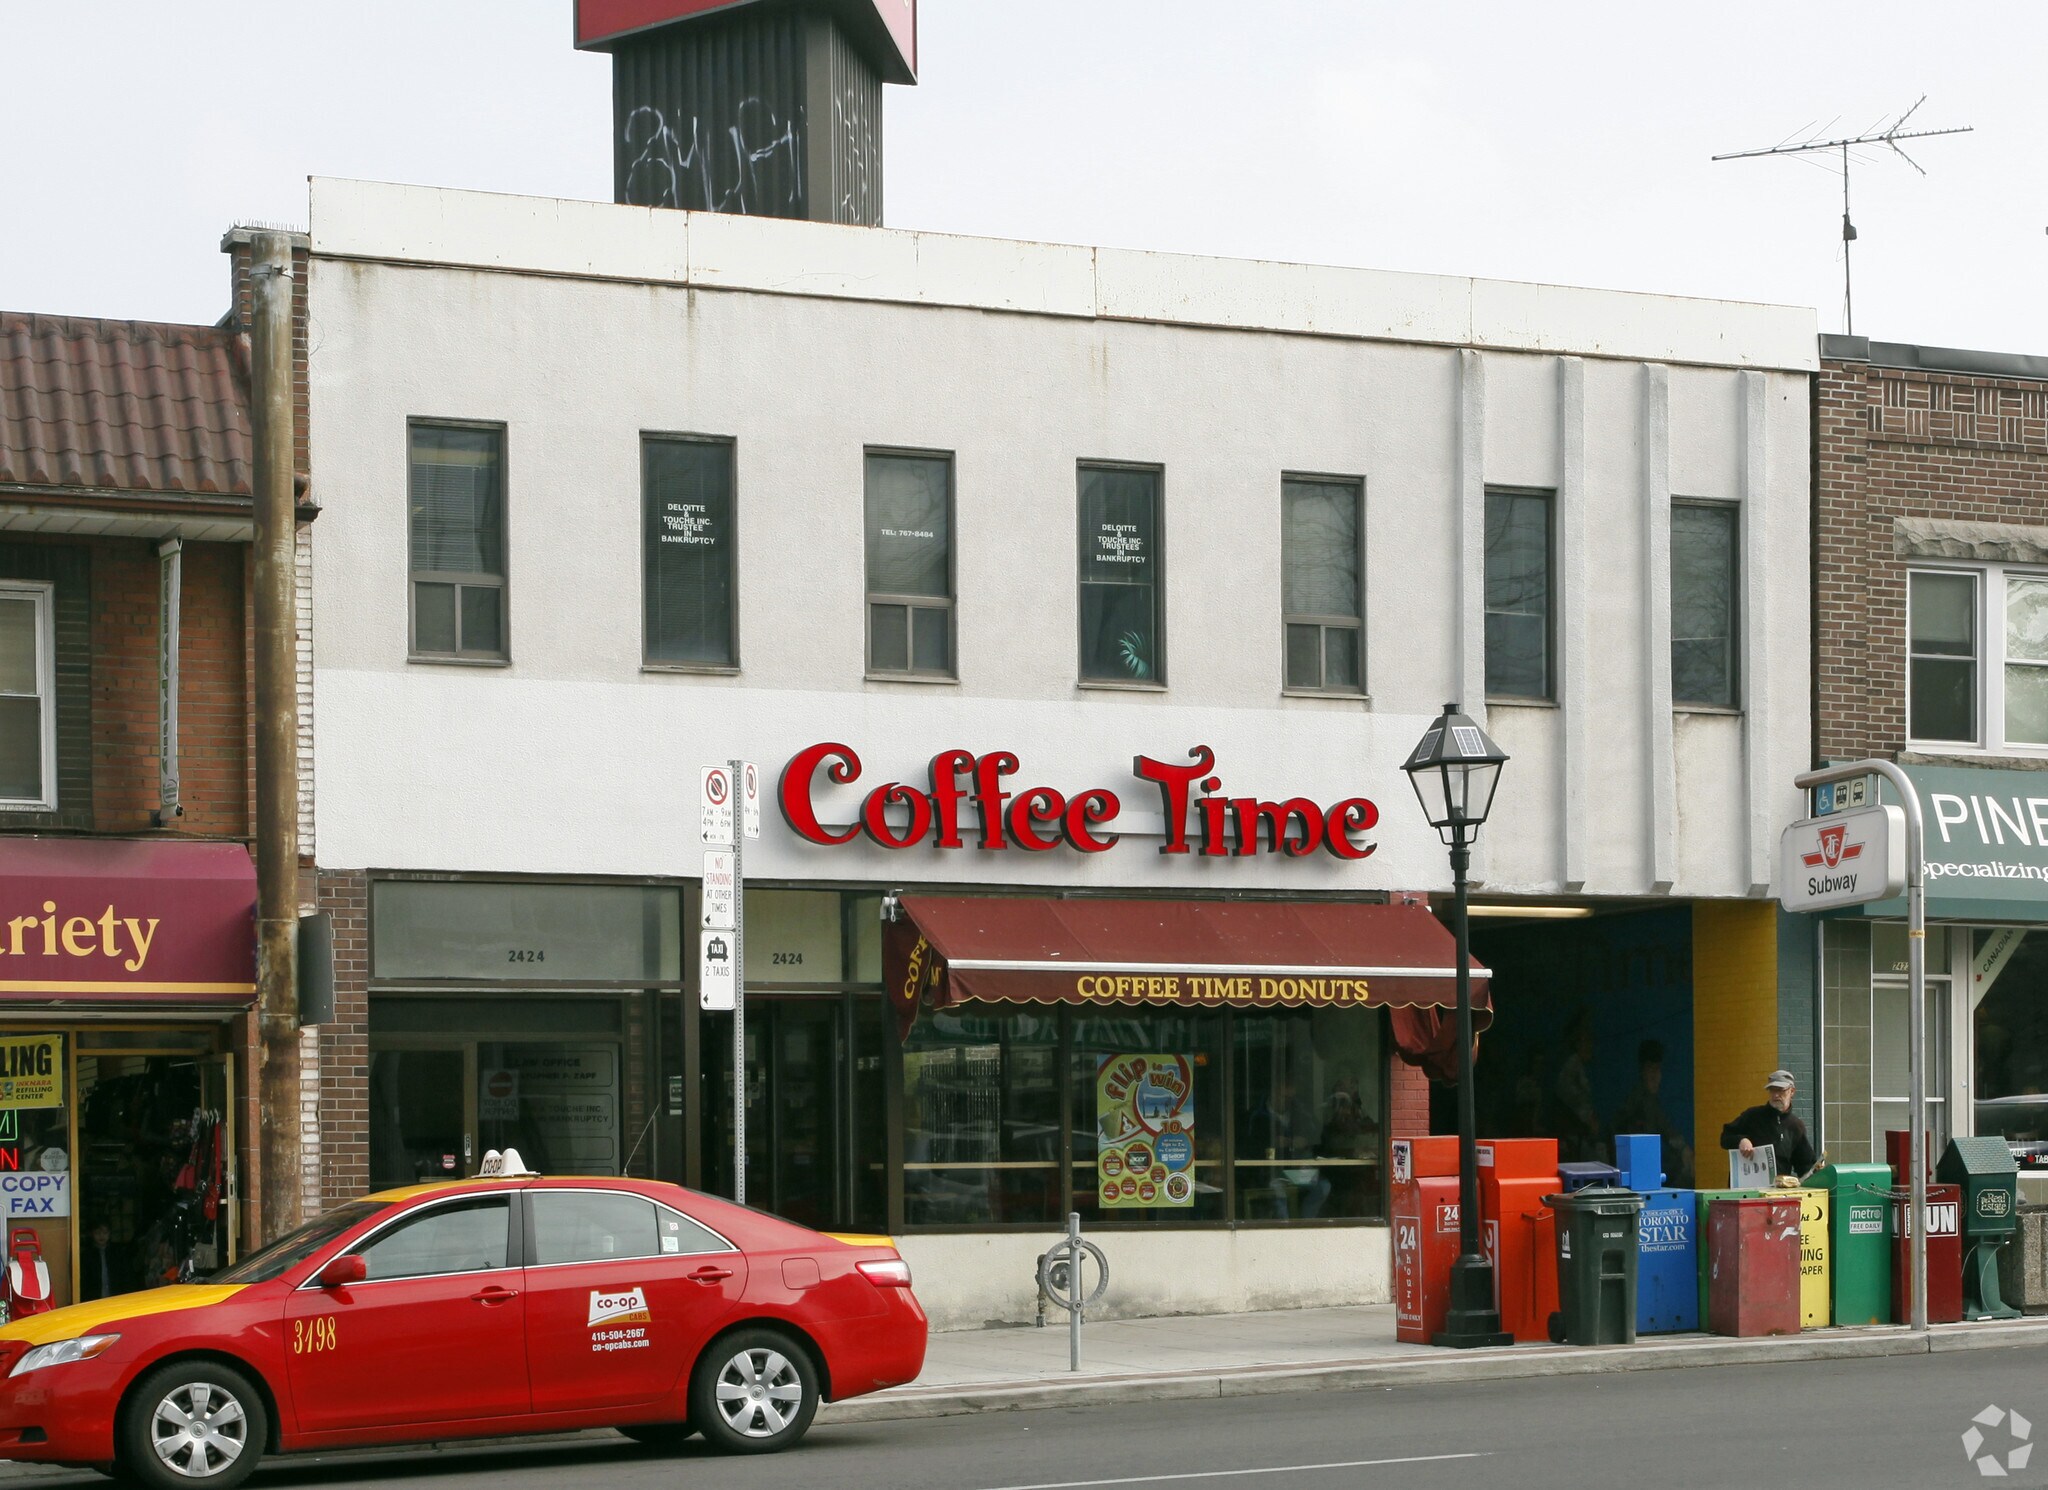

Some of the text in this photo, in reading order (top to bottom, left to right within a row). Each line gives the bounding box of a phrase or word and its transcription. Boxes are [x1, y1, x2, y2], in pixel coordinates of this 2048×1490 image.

[668, 504, 706, 512] DELOITTE
[663, 516, 694, 525] TOUCHE
[667, 523, 703, 531] TRUSTEE
[1102, 524, 1137, 532] DELOITTE
[661, 536, 715, 544] BANKRUPTCY
[1098, 536, 1127, 544] TOUCHE
[1102, 543, 1139, 551] TRUSTEES
[1096, 555, 1145, 563] BANKRUPTCY
[777, 743, 1379, 859] Coffee Time
[715, 858, 724, 869] NO
[706, 873, 732, 886] STANDING
[1808, 873, 1857, 896] Subway
[706, 890, 732, 900] AT OTHER
[712, 903, 728, 913] TIMES
[0, 900, 160, 972] riety
[711, 944, 724, 954] TAXI
[509, 950, 545, 963] 2424
[772, 953, 803, 964] 2424
[706, 966, 730, 977] 2 TAXIS
[1077, 976, 1369, 1001] COFFEE TIME DONUTS
[542, 1058, 581, 1067] OFFICE
[1105, 1058, 1147, 1101] flip
[1149, 1070, 1185, 1097] win
[1161, 1120, 1181, 1134] 10
[2, 1176, 66, 1192] COPY
[1987, 1193, 2006, 1203] Real
[11, 1198, 54, 1213] FAX
[1981, 1202, 2007, 1211] Estate
[1444, 1207, 1459, 1221] 24
[1852, 1209, 1881, 1219] metro
[1926, 1205, 1955, 1234] UN
[1639, 1215, 1689, 1226] TORONTO
[1400, 1226, 1416, 1250] 24
[1639, 1226, 1687, 1242] STAR
[1641, 1244, 1685, 1252] thestar.com
[597, 1297, 637, 1310] co-op
[629, 1312, 647, 1321] CABS
[293, 1316, 336, 1354] 3198
[591, 1328, 646, 1342] 416-504-2667
[592, 1339, 650, 1352] co-opcabs.com
